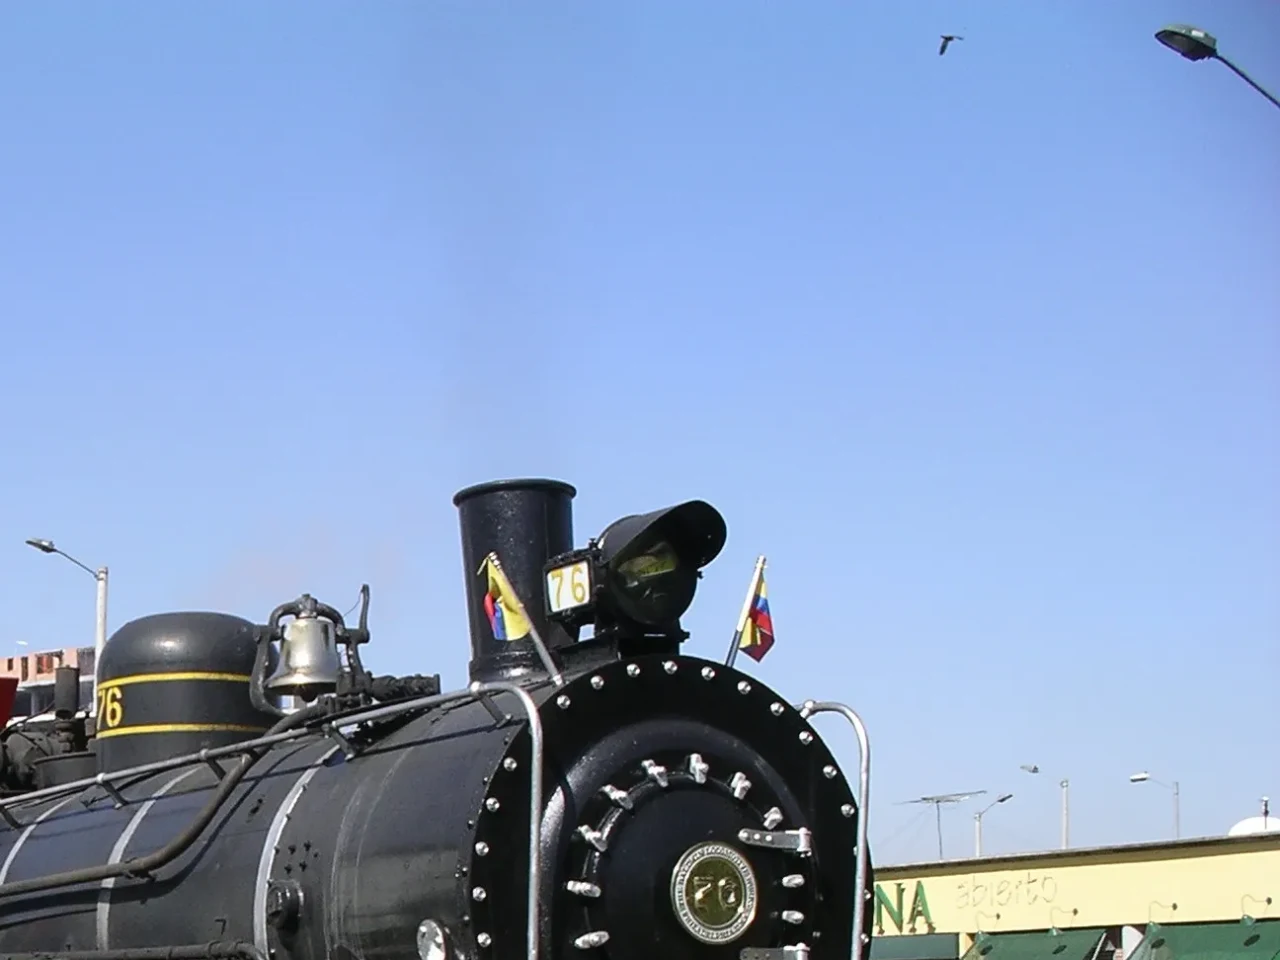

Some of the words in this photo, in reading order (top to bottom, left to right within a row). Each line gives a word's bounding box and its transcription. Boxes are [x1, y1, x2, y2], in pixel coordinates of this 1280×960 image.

[551, 563, 586, 608] 76
[96, 686, 123, 730] 76
[875, 880, 936, 935] NA
